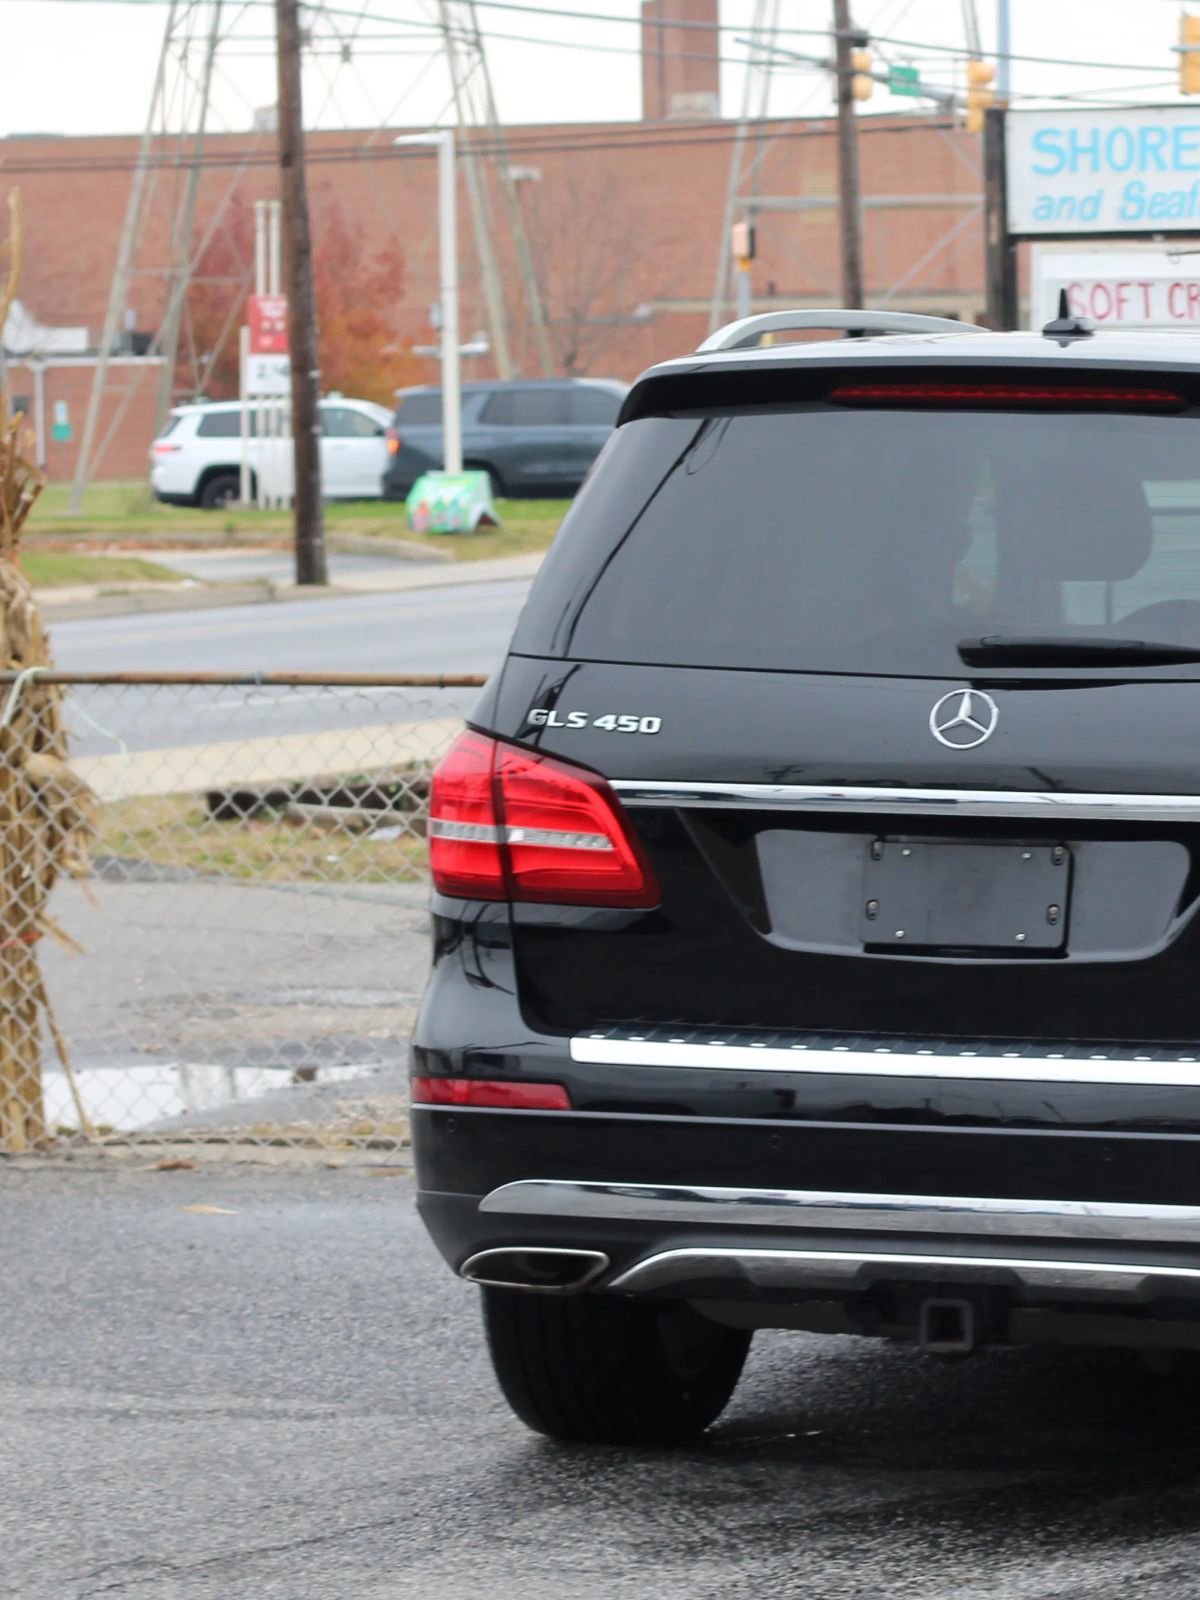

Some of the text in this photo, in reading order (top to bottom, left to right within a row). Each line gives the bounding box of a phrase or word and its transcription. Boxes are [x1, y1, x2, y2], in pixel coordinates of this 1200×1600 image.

[1033, 188, 1104, 222] and
[1067, 281, 1153, 320] SOFT
[527, 709, 662, 734] GLS 450
